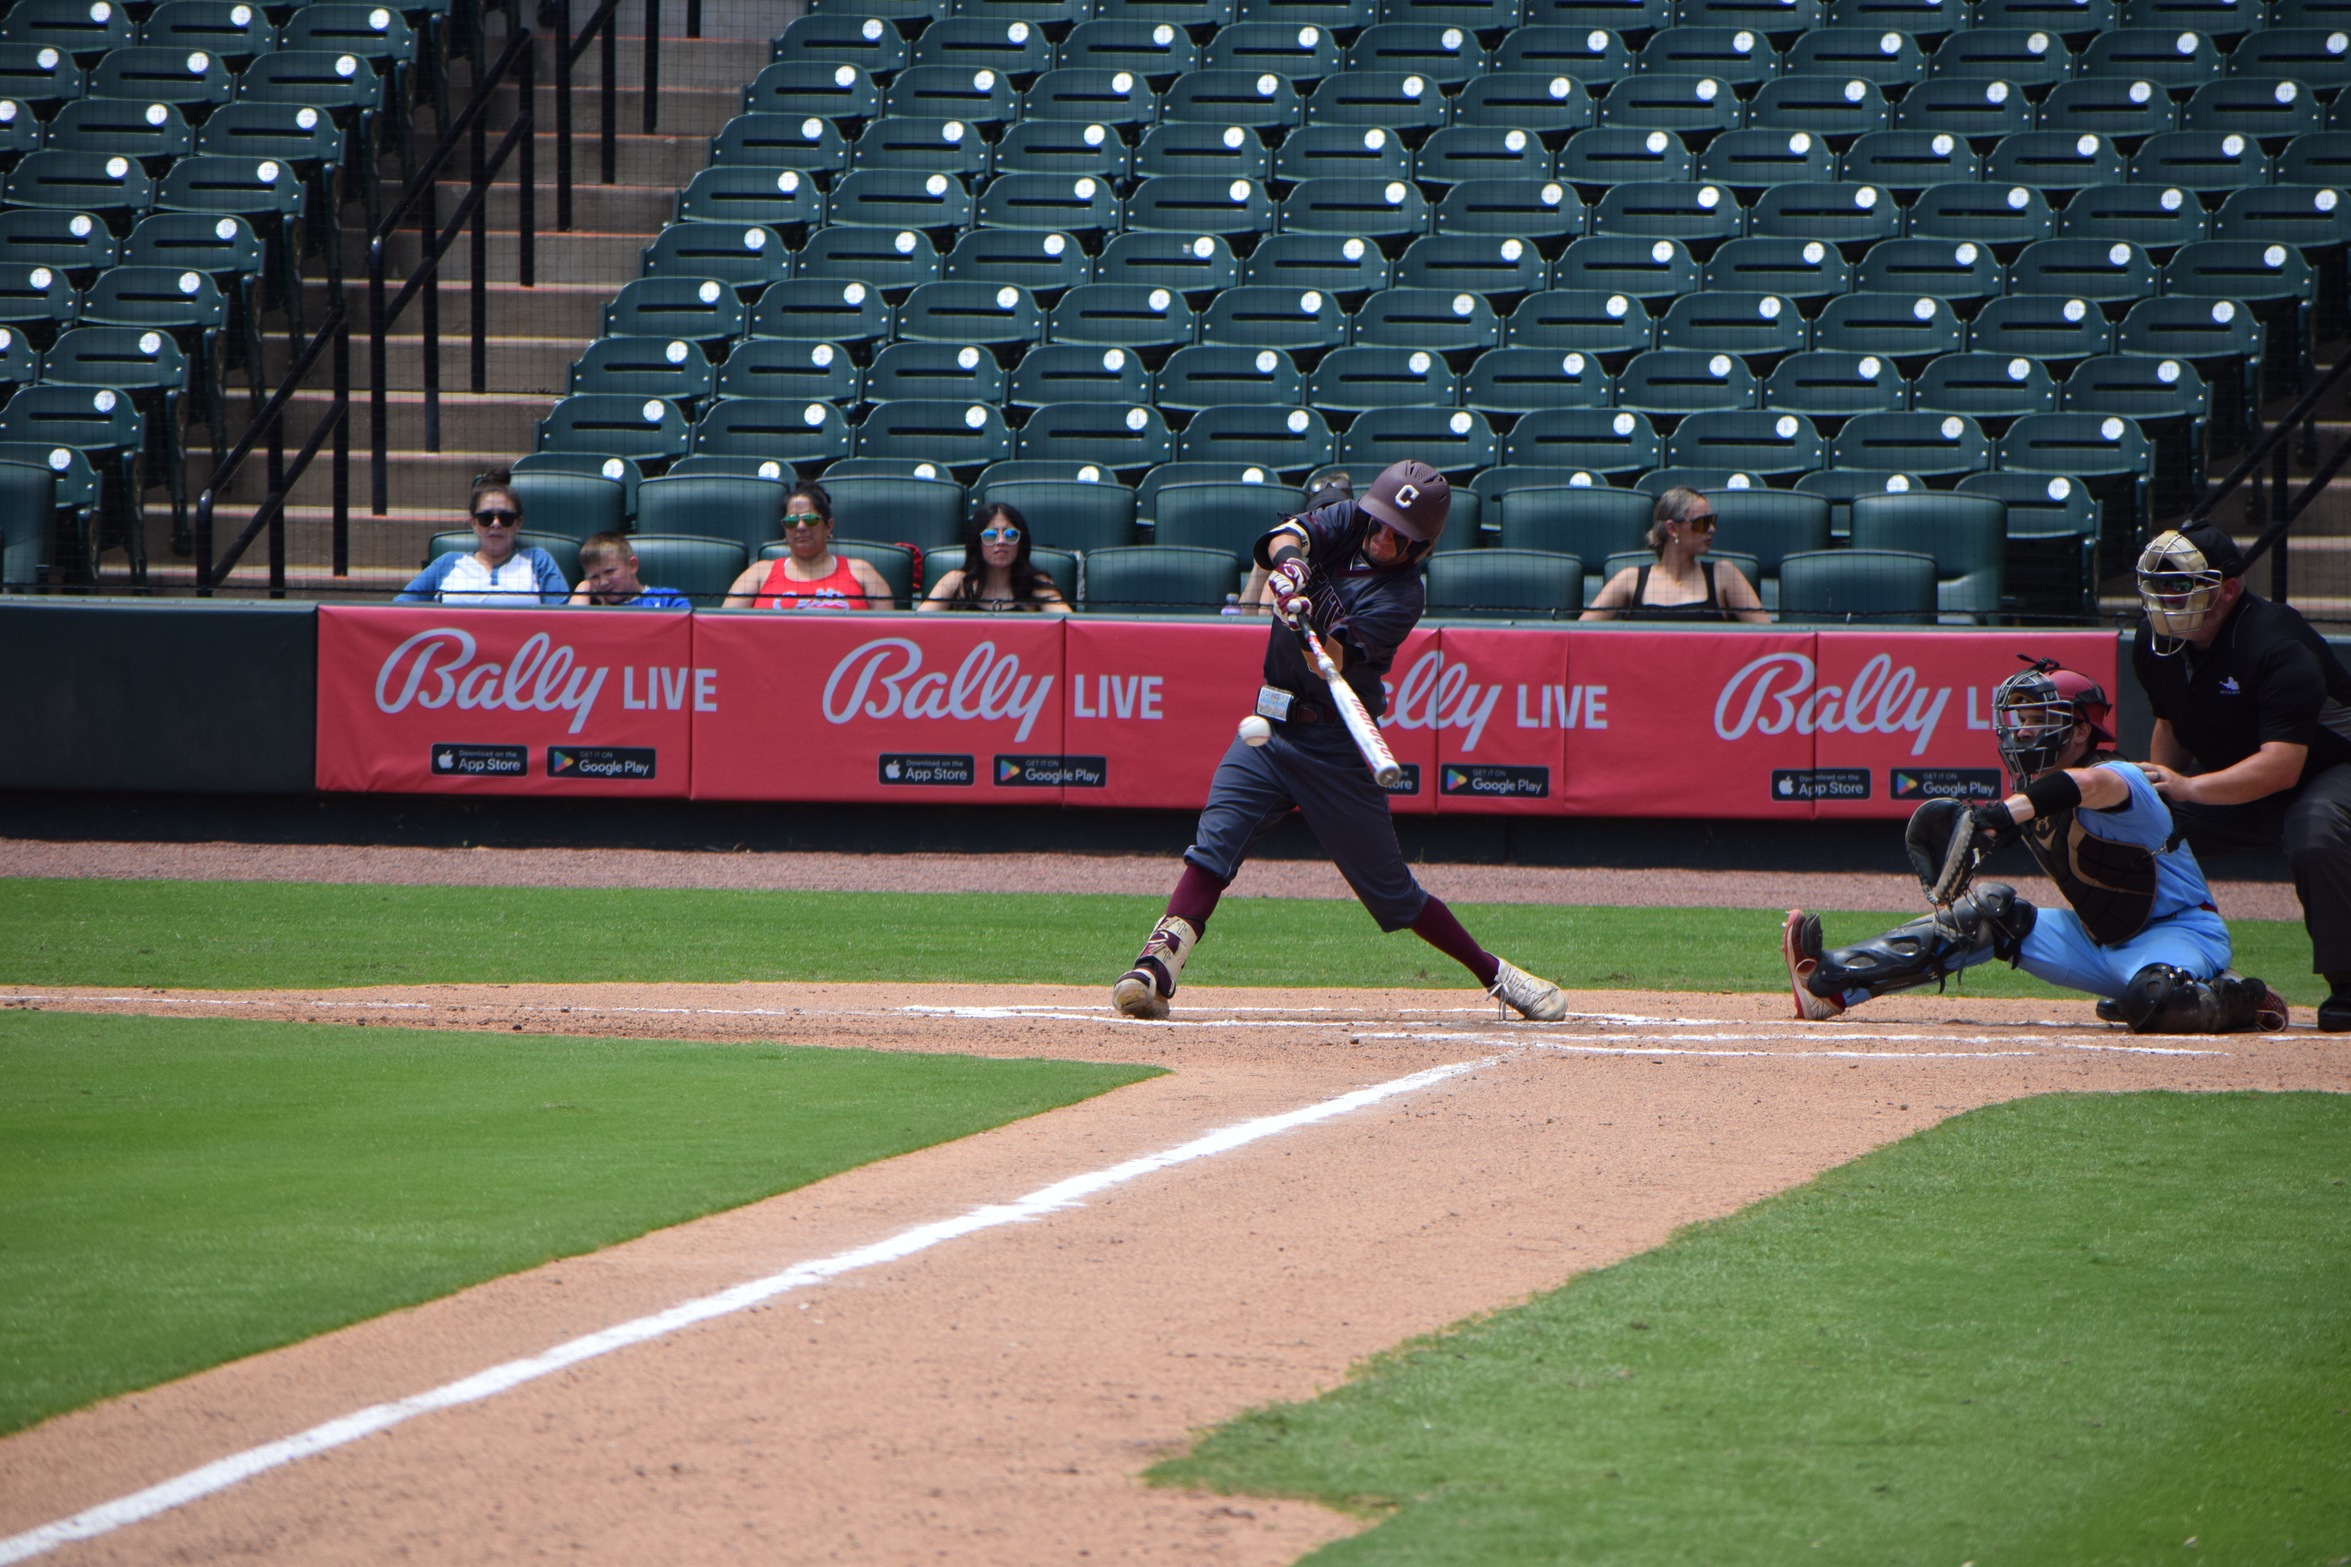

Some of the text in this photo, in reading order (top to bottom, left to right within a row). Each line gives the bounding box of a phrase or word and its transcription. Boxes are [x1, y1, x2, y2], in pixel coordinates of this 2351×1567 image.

[1394, 484, 1420, 509] C
[375, 627, 718, 734] Bally LIVE
[822, 637, 1163, 744] Bally LIVE
[1377, 650, 1608, 752] lly LIVE
[1714, 652, 1952, 756] Bally
[458, 758, 521, 772] App Store
[579, 759, 649, 776] Google Play
[905, 767, 967, 782] App Store
[1025, 768, 1100, 784] Google Play
[1472, 778, 1543, 795] Google Play
[1799, 781, 1864, 797] App Store
[1923, 781, 1995, 797] Google Play
